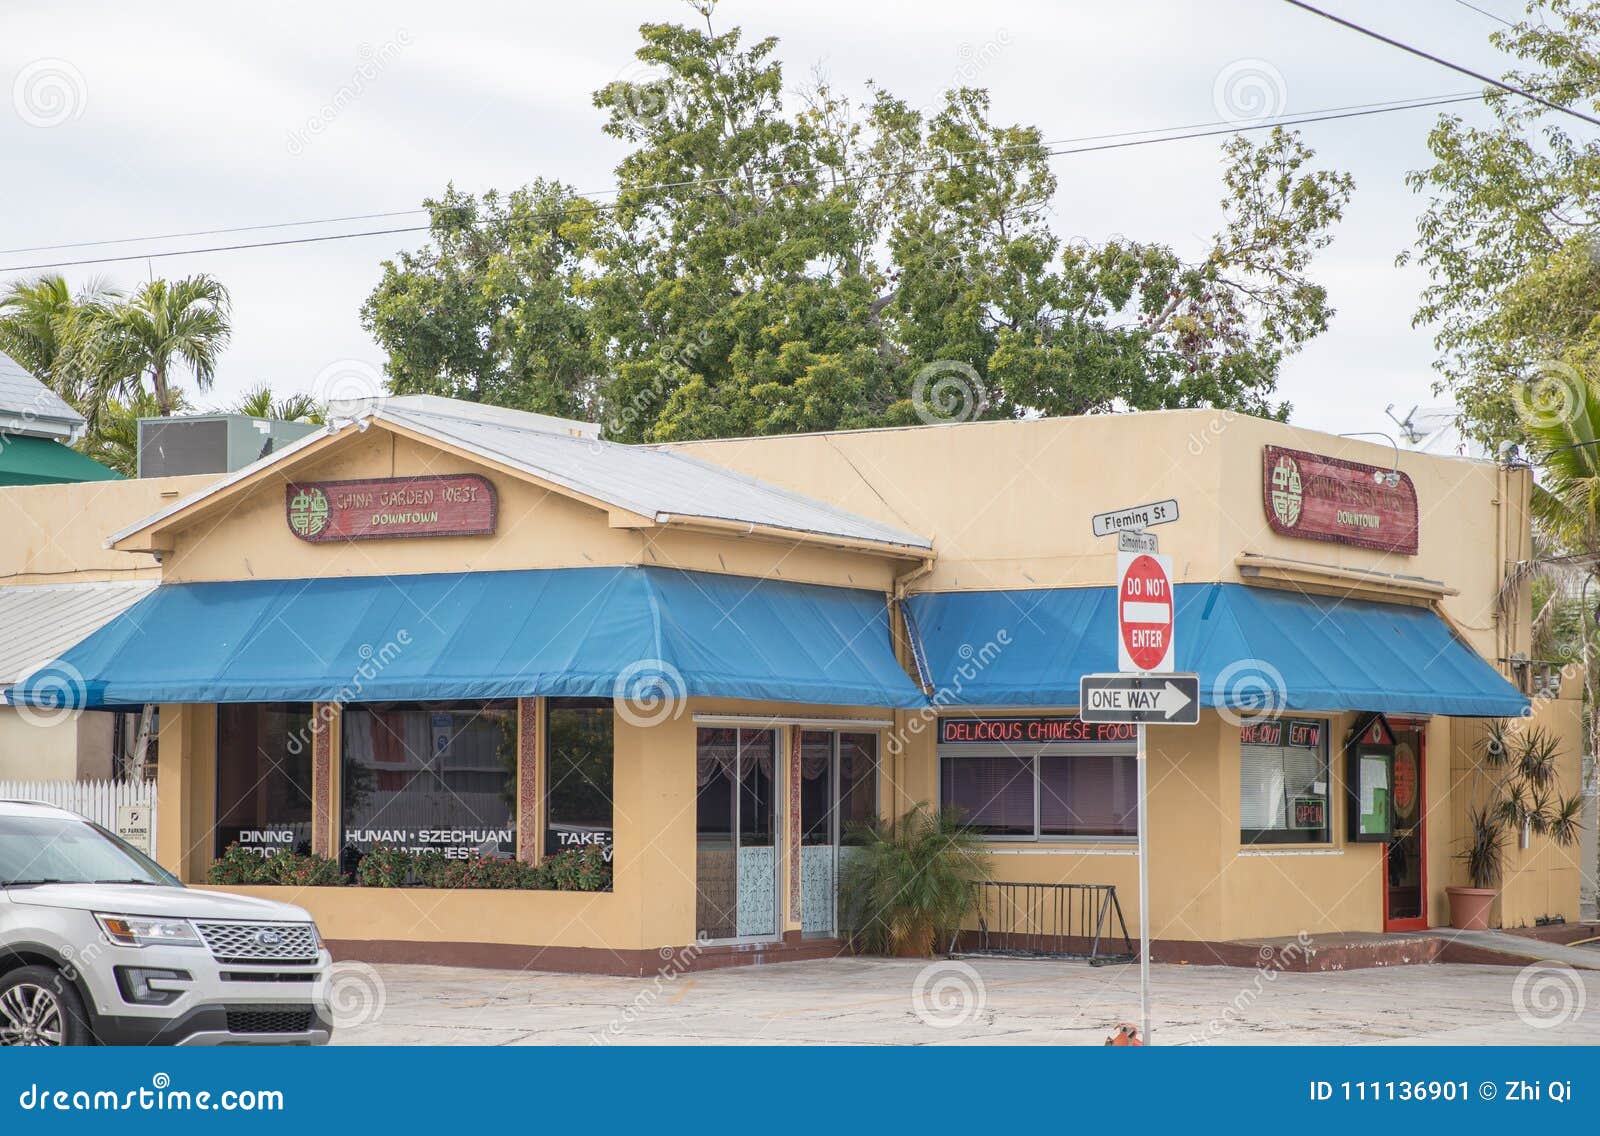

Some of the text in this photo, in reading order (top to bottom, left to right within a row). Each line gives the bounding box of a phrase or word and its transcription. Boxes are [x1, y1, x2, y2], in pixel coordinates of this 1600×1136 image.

[380, 489, 434, 506] GARDEN
[442, 486, 479, 502] WEST
[372, 511, 438, 525] DOWNTOWN
[1105, 506, 1166, 530] Fleming St
[1337, 510, 1380, 529] DOWNTOWN
[1122, 534, 1156, 551] Simonton St
[1127, 577, 1165, 596] DO NOT
[1131, 629, 1163, 648] ENTER
[1092, 690, 1161, 709] ONE WAY
[945, 722, 1022, 741] DELICIOUS
[1028, 722, 1091, 740] CHINESE
[1240, 724, 1280, 745] AKE-OUT
[1291, 726, 1319, 745] EAT IN
[1296, 805, 1322, 823] OPEN
[240, 830, 293, 843] DINING
[346, 830, 512, 843] HUNAN SZECHUAN
